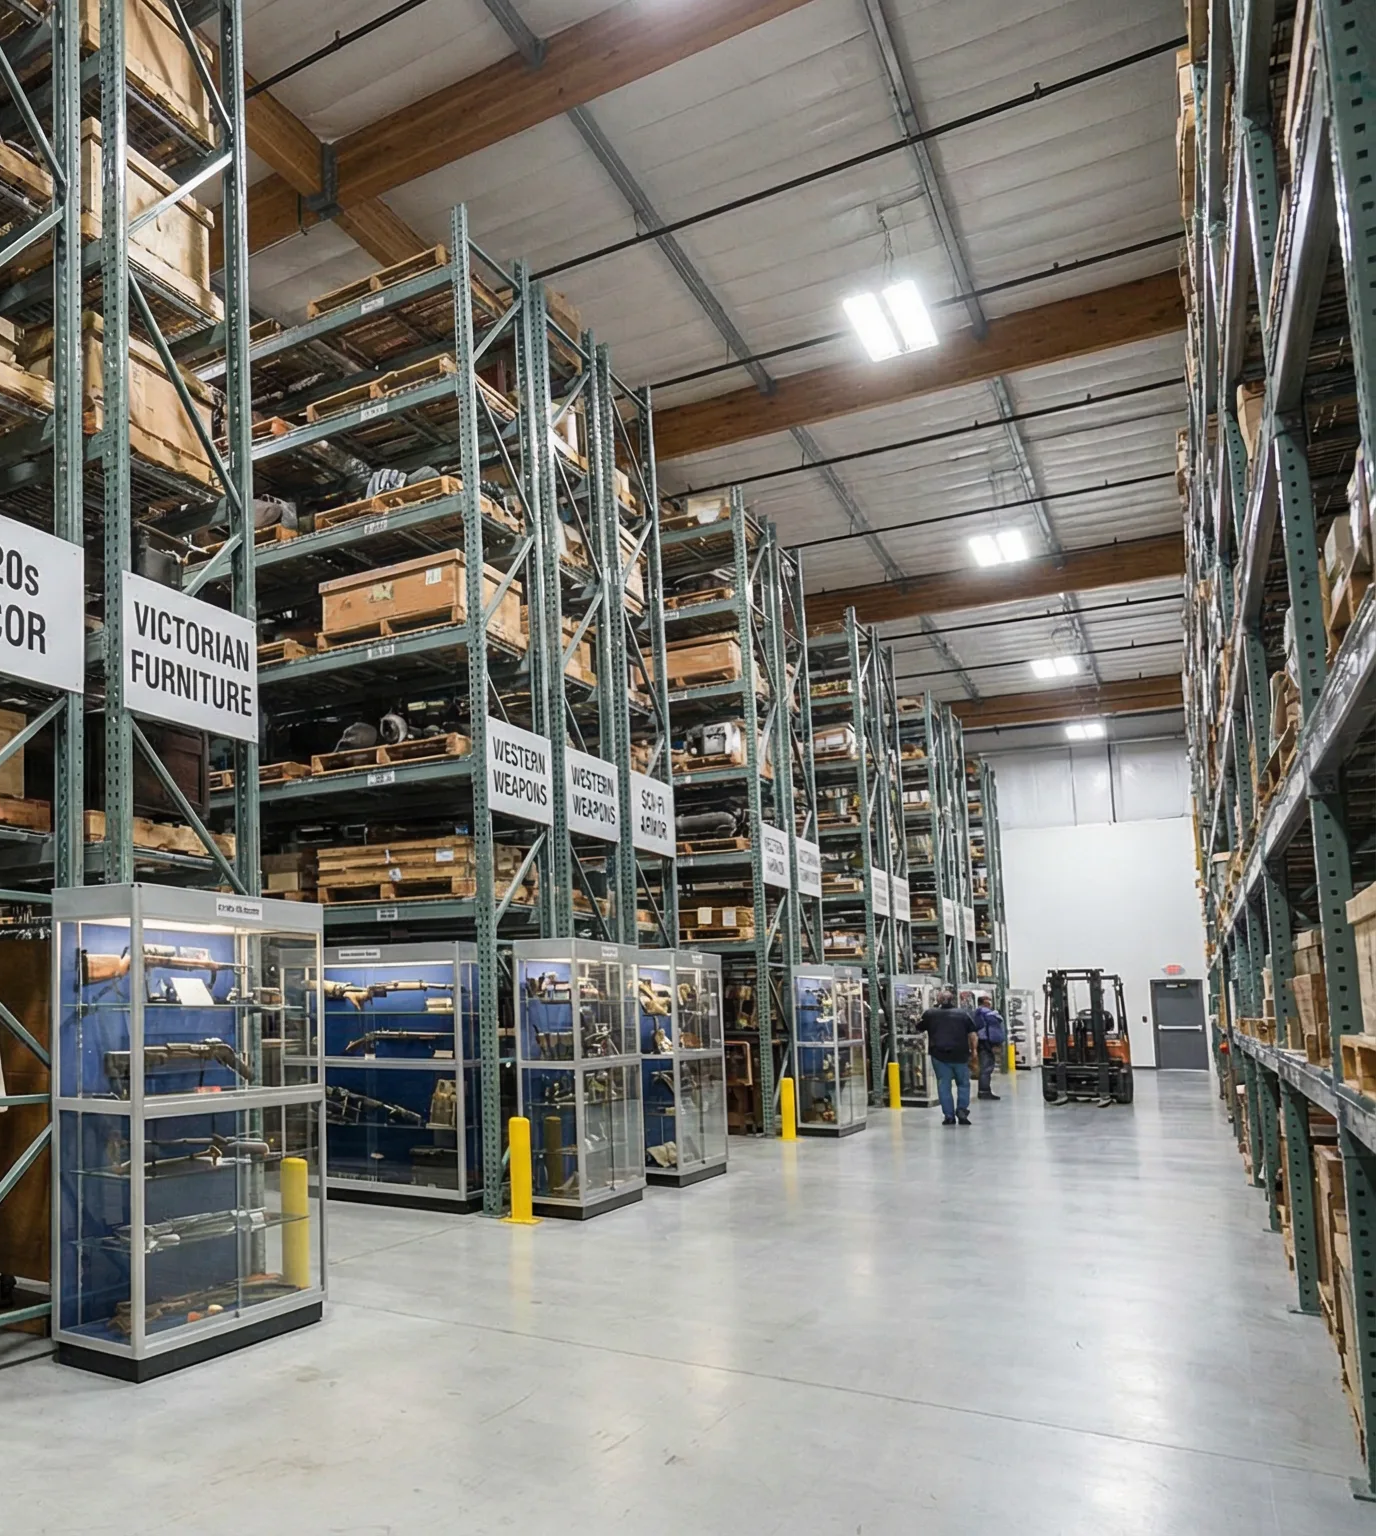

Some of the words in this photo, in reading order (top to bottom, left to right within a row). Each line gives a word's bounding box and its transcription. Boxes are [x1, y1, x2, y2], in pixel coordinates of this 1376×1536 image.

[133, 600, 250, 673] VICTORIAN
[131, 650, 253, 717] FURNITURE
[492, 735, 546, 776] WESTERN
[493, 769, 548, 806] WEAPONS
